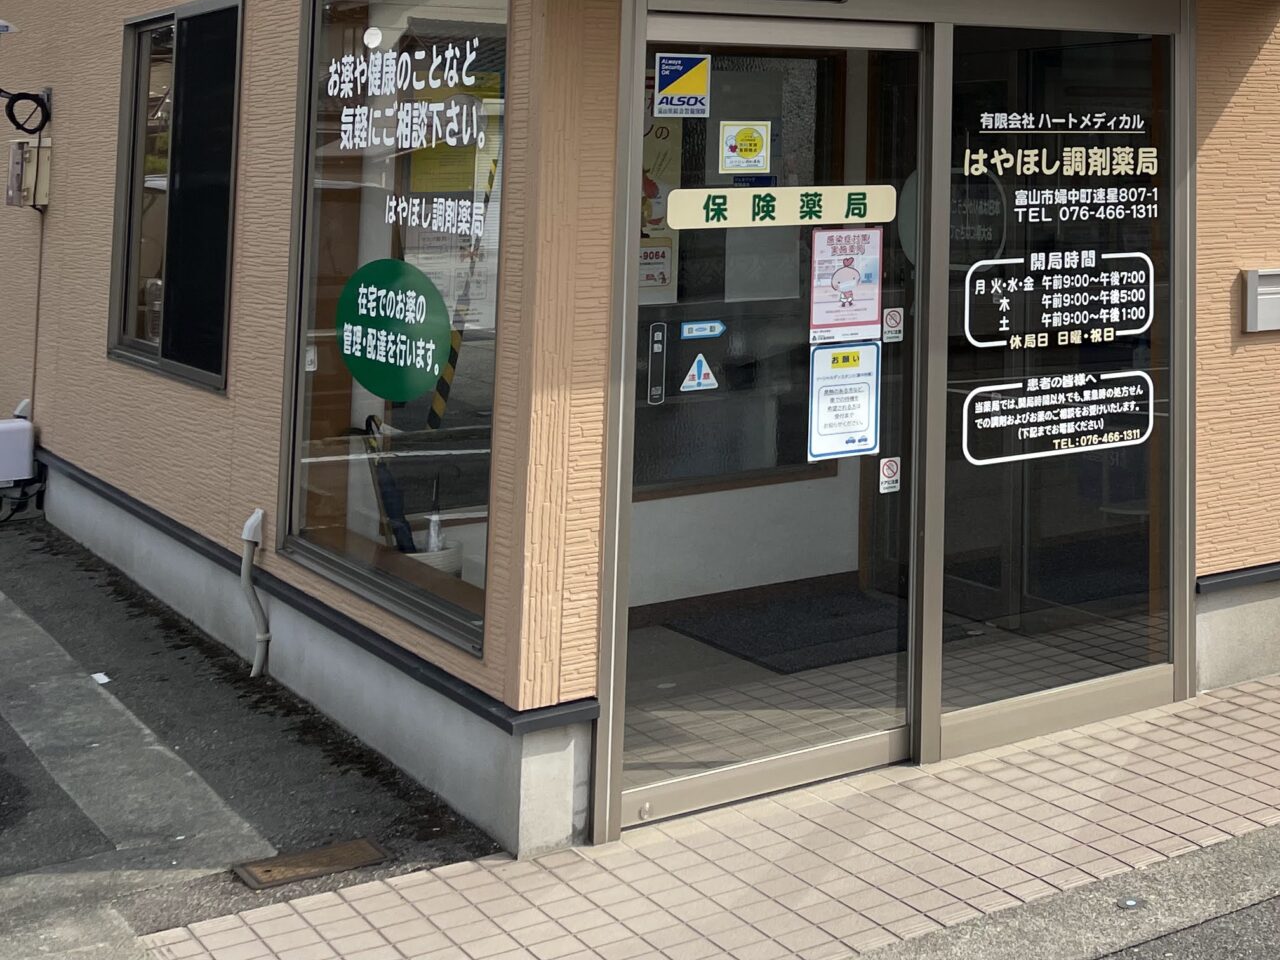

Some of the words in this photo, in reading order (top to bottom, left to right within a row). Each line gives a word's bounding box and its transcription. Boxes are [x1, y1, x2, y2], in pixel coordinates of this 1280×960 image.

[327, 37, 479, 98] お薬や健康のことなど
[658, 96, 706, 106] ALSOK
[339, 99, 486, 151] 気軽にご相談下さい。
[963, 146, 1158, 176] はやほし調剤薬局
[703, 192, 868, 223] 保険薬局
[1014, 187, 1158, 206] 富山市婦中町速星807-1
[385, 195, 485, 238] はやほし調剤薬局
[1013, 207, 1053, 223] TEL
[1059, 204, 1158, 221] 076-466-1311
[1030, 250, 1096, 272] 開局時間
[357, 283, 427, 325] 在宅でのお薬の
[999, 297, 1010, 313] 木
[999, 317, 1010, 331] 土
[342, 322, 441, 376] 管理・配達を行います。
[1009, 332, 1049, 350] 休局日
[1058, 327, 1115, 345] 日曜・祝日
[832, 355, 860, 364] お願い
[1026, 373, 1097, 392] 患者の皆様へ
